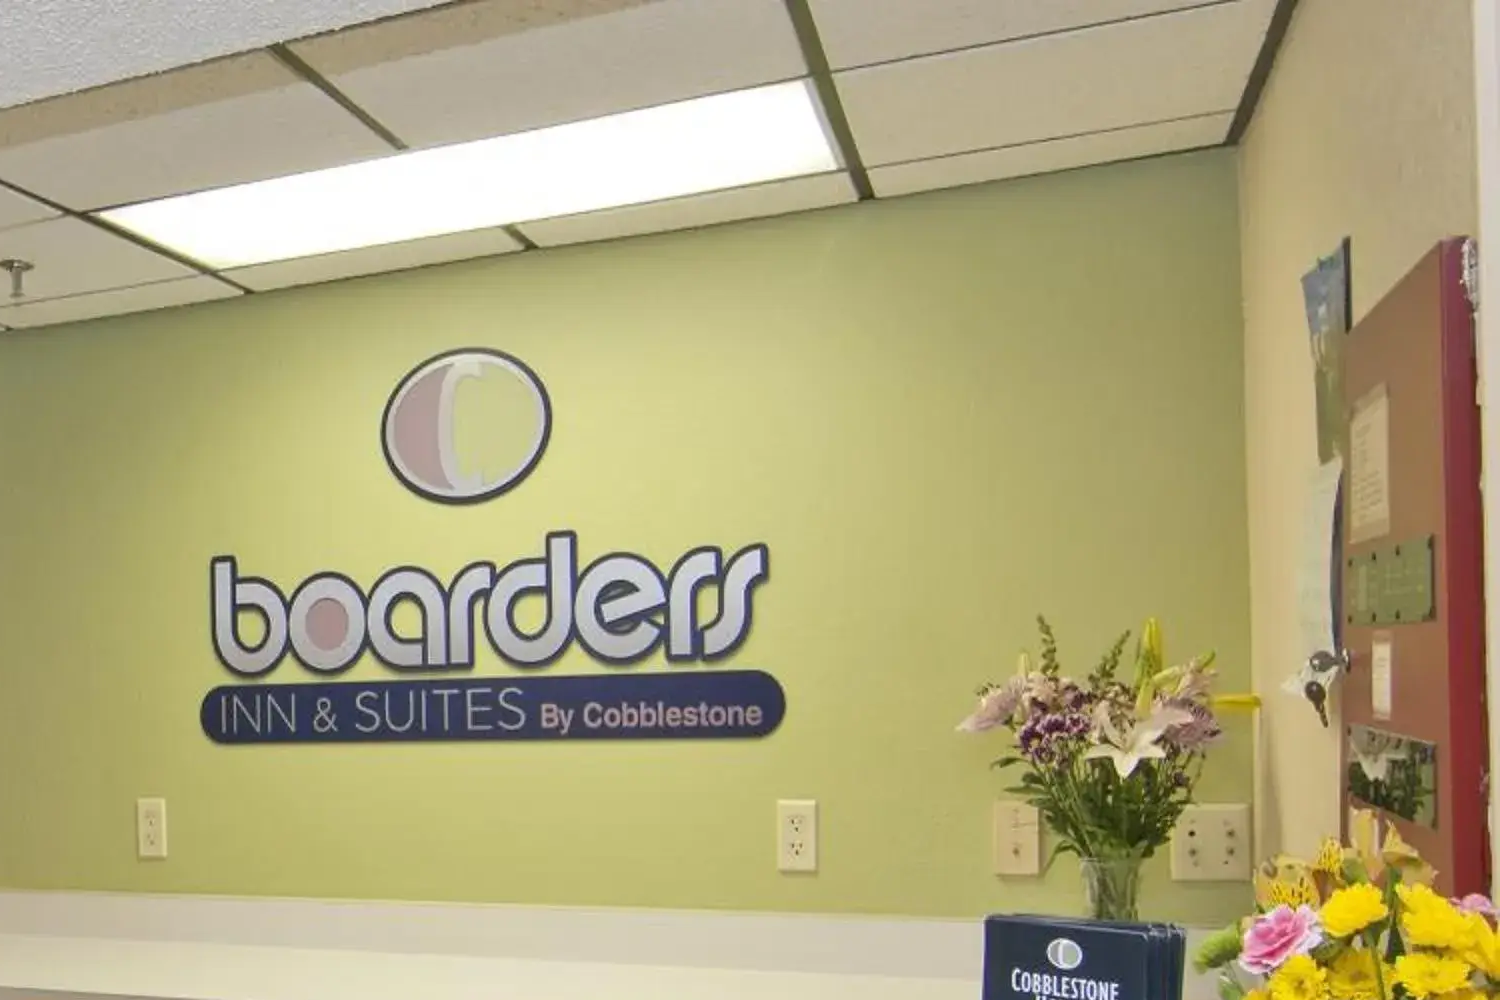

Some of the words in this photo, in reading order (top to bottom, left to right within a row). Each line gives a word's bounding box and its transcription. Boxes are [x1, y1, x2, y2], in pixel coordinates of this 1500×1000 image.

[210, 530, 769, 678] boarders
[220, 693, 298, 734] INN
[312, 697, 338, 734] &
[354, 687, 527, 732] SUITES
[540, 703, 573, 735] By
[583, 701, 764, 729] Cobblestone
